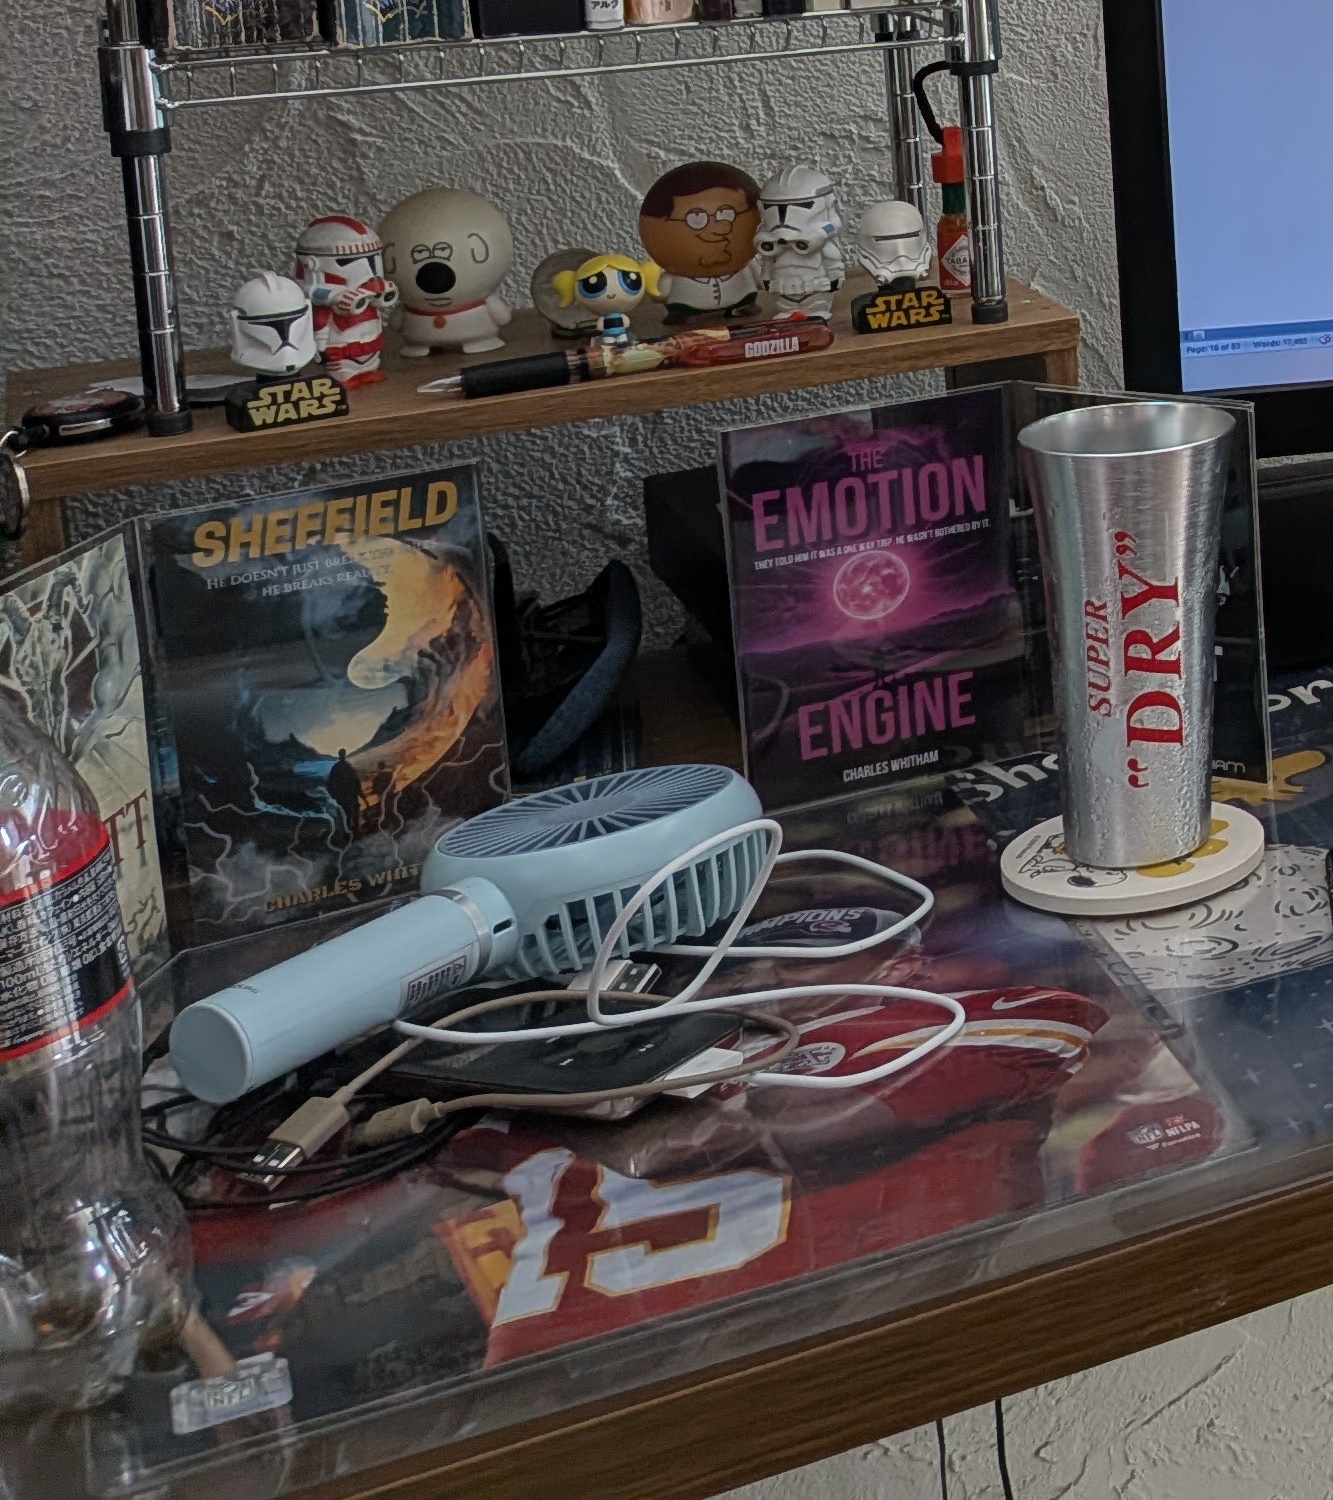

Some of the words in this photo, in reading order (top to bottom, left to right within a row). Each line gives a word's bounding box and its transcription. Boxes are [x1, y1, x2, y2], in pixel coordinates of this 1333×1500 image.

[590, 0, 619, 10] アルク
[945, 256, 969, 265] TABA
[866, 290, 945, 313] STAR
[867, 305, 945, 330] WARS
[744, 336, 800, 358] GODZILLA
[247, 378, 340, 408] STAR
[247, 394, 341, 427] WARS
[848, 449, 884, 471] THE
[751, 455, 987, 553] EMOTION
[192, 480, 459, 569] SHEFFIELD
[206, 577, 227, 591] HE
[230, 565, 290, 586] DOESN'T
[292, 560, 319, 577] JUST
[262, 585, 280, 597] HE
[283, 575, 334, 594] BREAKS
[1084, 598, 1112, 718] SUPER
[1113, 531, 1185, 790] “DRY”
[797, 671, 977, 762] ENGINE
[842, 759, 889, 783] CHARLES
[890, 749, 939, 776] WHITHAM
[263, 876, 362, 913] CHARLES
[367, 862, 421, 887] WHIT
[1165, 1121, 1201, 1137] NFLPA
